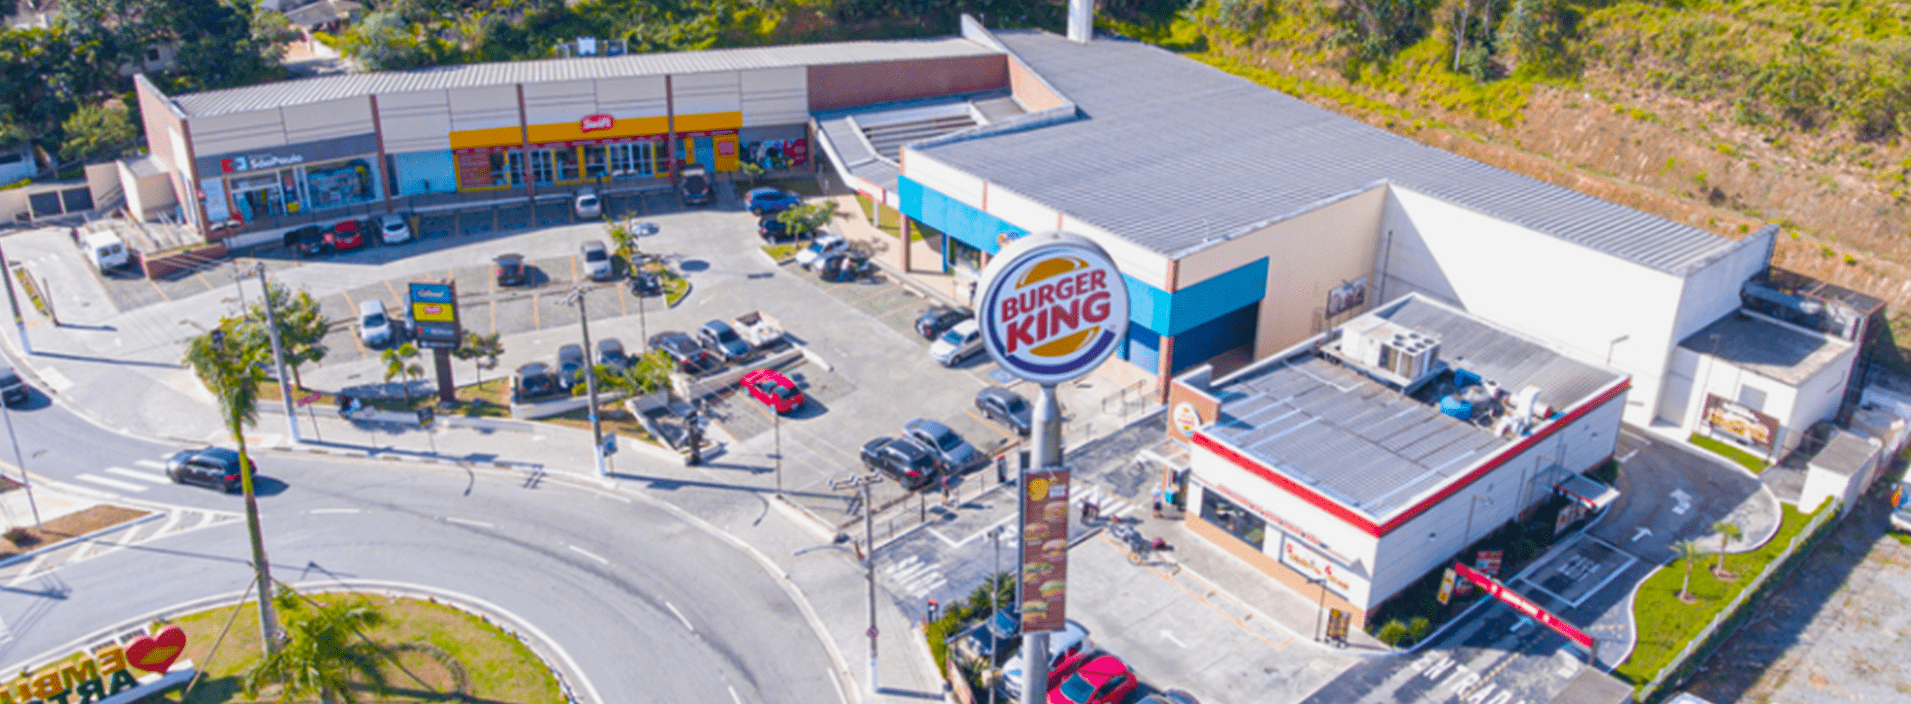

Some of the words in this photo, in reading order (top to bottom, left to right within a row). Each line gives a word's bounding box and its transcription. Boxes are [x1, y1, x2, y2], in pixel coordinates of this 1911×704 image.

[1001, 269, 1107, 323] BURGER
[1006, 291, 1112, 354] KING
[1409, 649, 1526, 704] ENTRAD
